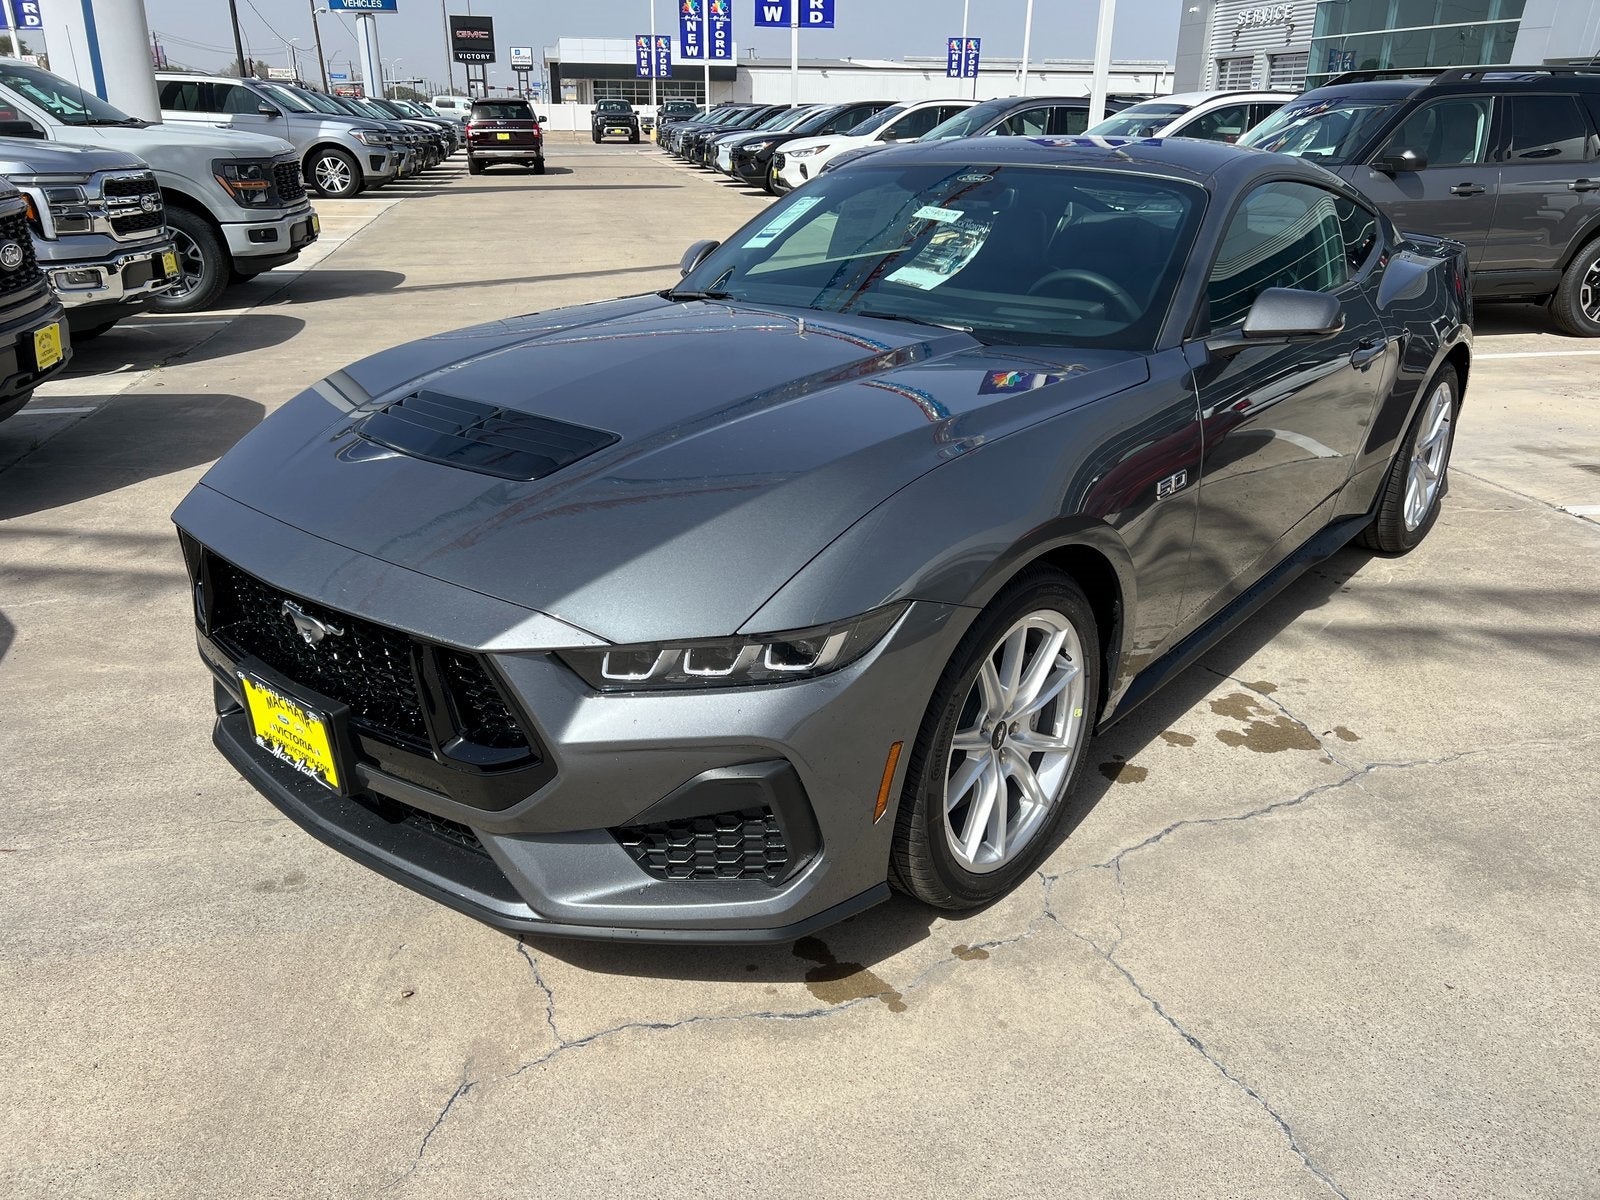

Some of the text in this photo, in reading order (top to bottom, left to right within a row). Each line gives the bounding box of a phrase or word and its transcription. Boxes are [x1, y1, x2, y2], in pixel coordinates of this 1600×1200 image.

[22, 2, 40, 26] RD
[809, 0, 824, 23] RD
[1237, 3, 1293, 25] SERVICE
[456, 30, 489, 38] GMC
[685, 21, 699, 56] NEW
[714, 21, 725, 57] FORD
[639, 51, 649, 75] NEW
[659, 52, 667, 76] FORD
[950, 54, 958, 77] NEW
[967, 53, 975, 77] FORD
[266, 695, 285, 710] MAC
[275, 724, 315, 754] VICTORIA
